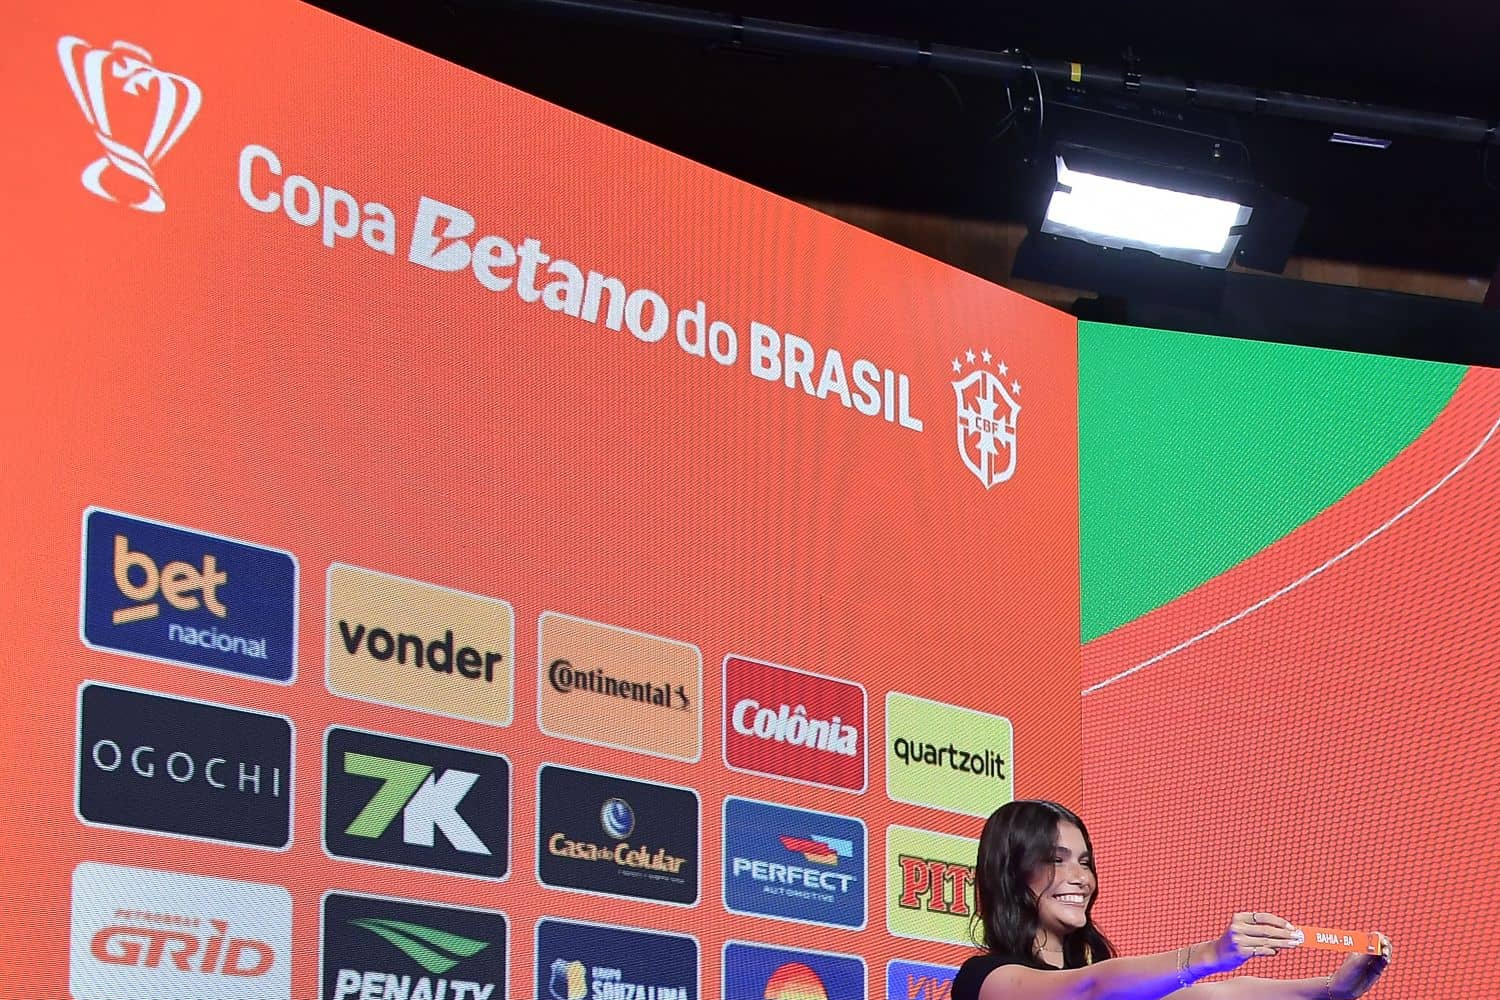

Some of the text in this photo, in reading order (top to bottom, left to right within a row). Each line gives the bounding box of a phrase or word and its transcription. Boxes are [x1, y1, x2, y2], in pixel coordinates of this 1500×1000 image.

[237, 144, 923, 432] Copa Betano do BRASIL
[975, 416, 998, 434] CBF
[112, 534, 228, 619] bet
[168, 621, 268, 660] nacional
[338, 619, 502, 683] vonder
[548, 657, 672, 709] Continental
[732, 699, 858, 757] Colônia
[92, 739, 280, 798] OGOCHI
[893, 736, 1006, 780] quartzolit
[343, 751, 493, 856] 7K
[548, 832, 598, 861] Casa
[614, 842, 686, 874] Celular
[733, 857, 854, 893] PERFECT
[899, 854, 976, 917] PIT
[1316, 932, 1339, 945] BAHIA
[1343, 935, 1354, 946] BA
